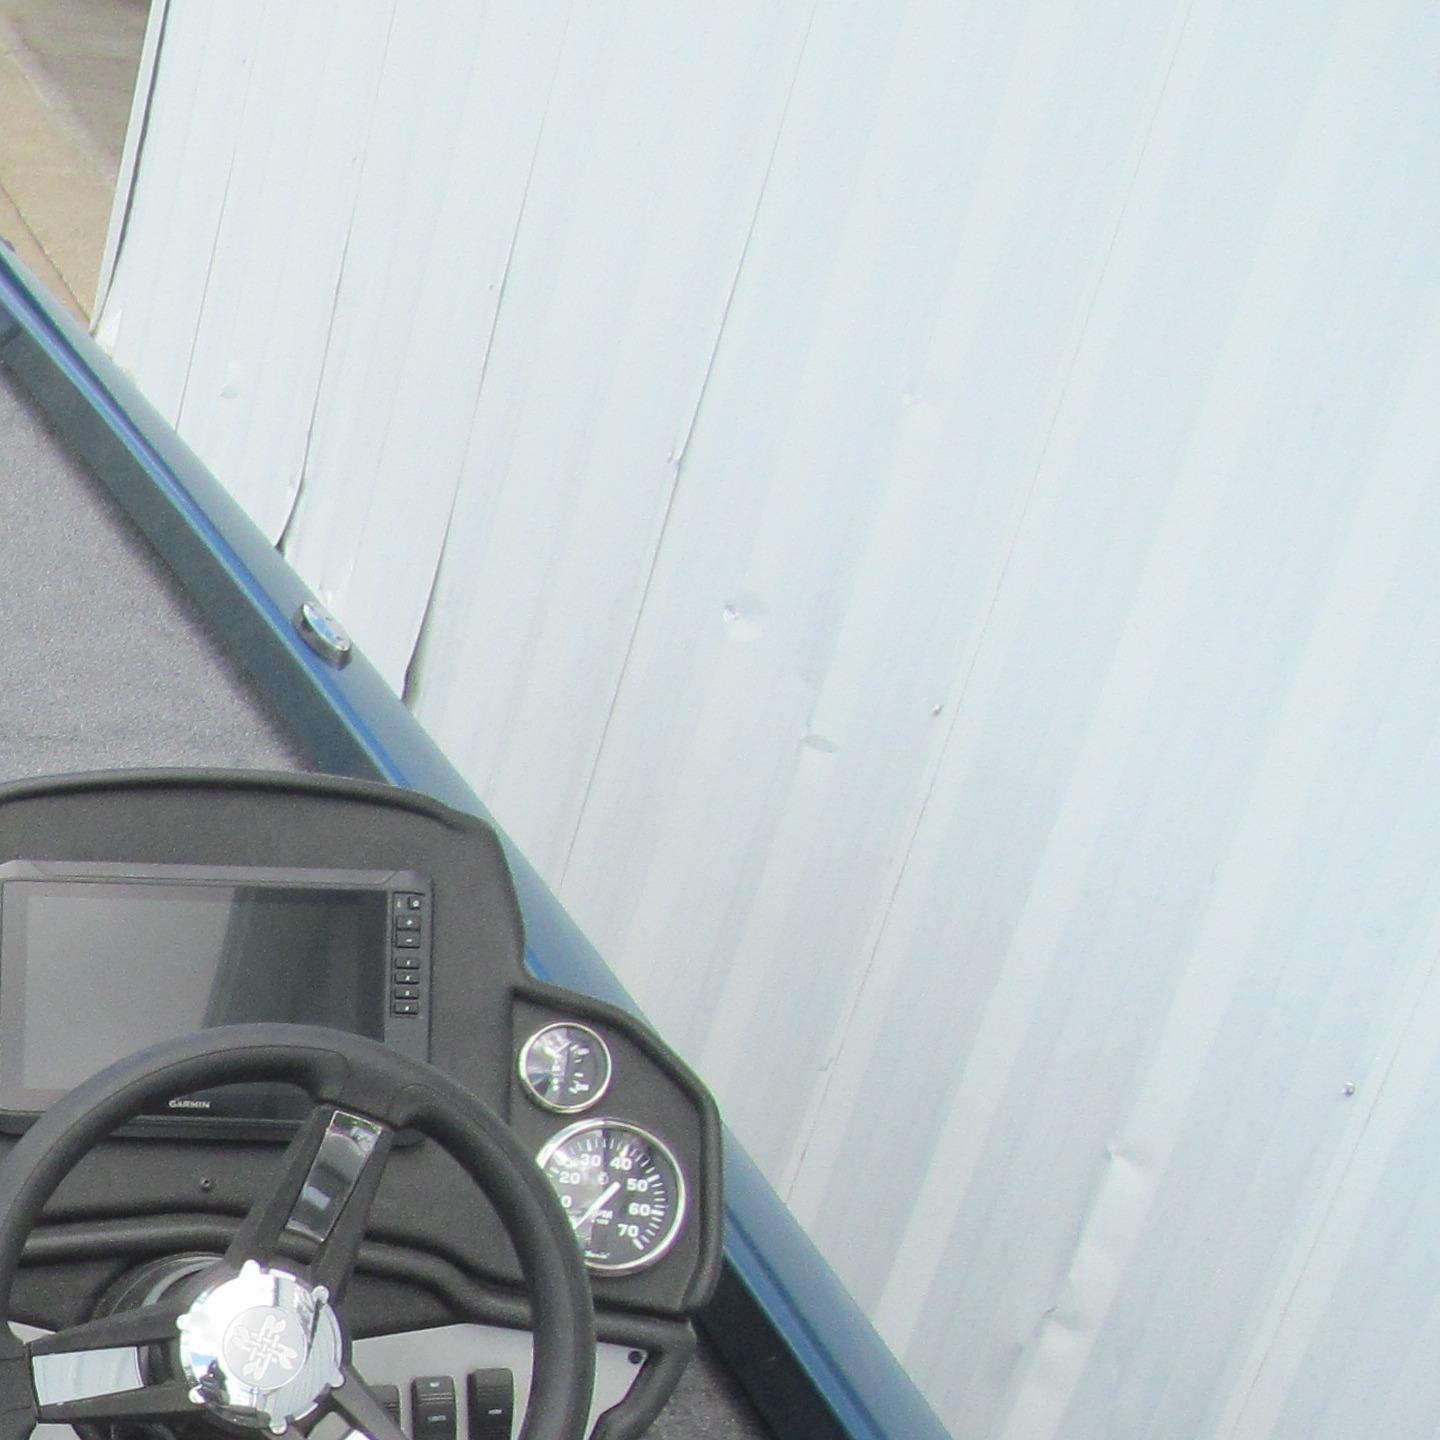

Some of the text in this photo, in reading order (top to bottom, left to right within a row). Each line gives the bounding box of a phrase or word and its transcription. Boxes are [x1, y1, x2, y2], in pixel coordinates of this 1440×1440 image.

[168, 1100, 211, 1109] GARMIN
[580, 1154, 602, 1167] 30
[609, 1157, 633, 1171] 40
[559, 1172, 580, 1185] 20
[626, 1178, 649, 1192] 50
[628, 1202, 651, 1216] 60
[617, 1223, 640, 1237] 70
